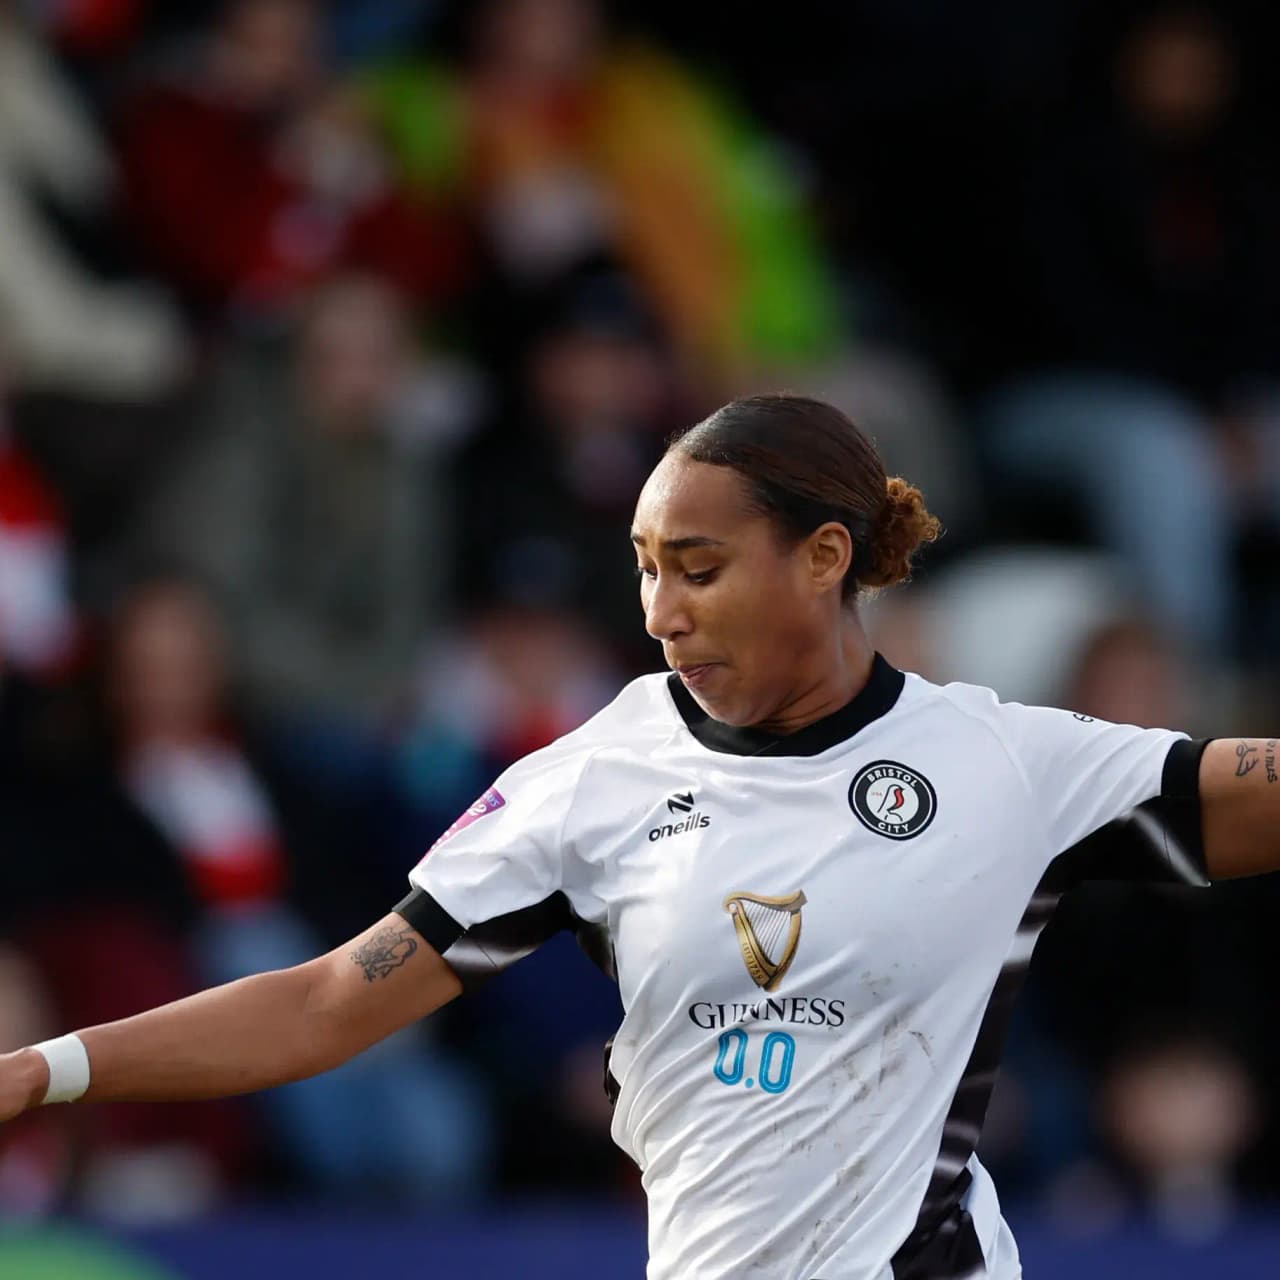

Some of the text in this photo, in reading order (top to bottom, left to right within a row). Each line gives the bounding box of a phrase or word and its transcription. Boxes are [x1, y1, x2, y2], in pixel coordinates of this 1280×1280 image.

[866, 767, 919, 788] BRISTOL
[877, 821, 910, 834] CITY
[688, 997, 846, 1030] GUINNESS
[713, 1026, 797, 1095] 0.0
